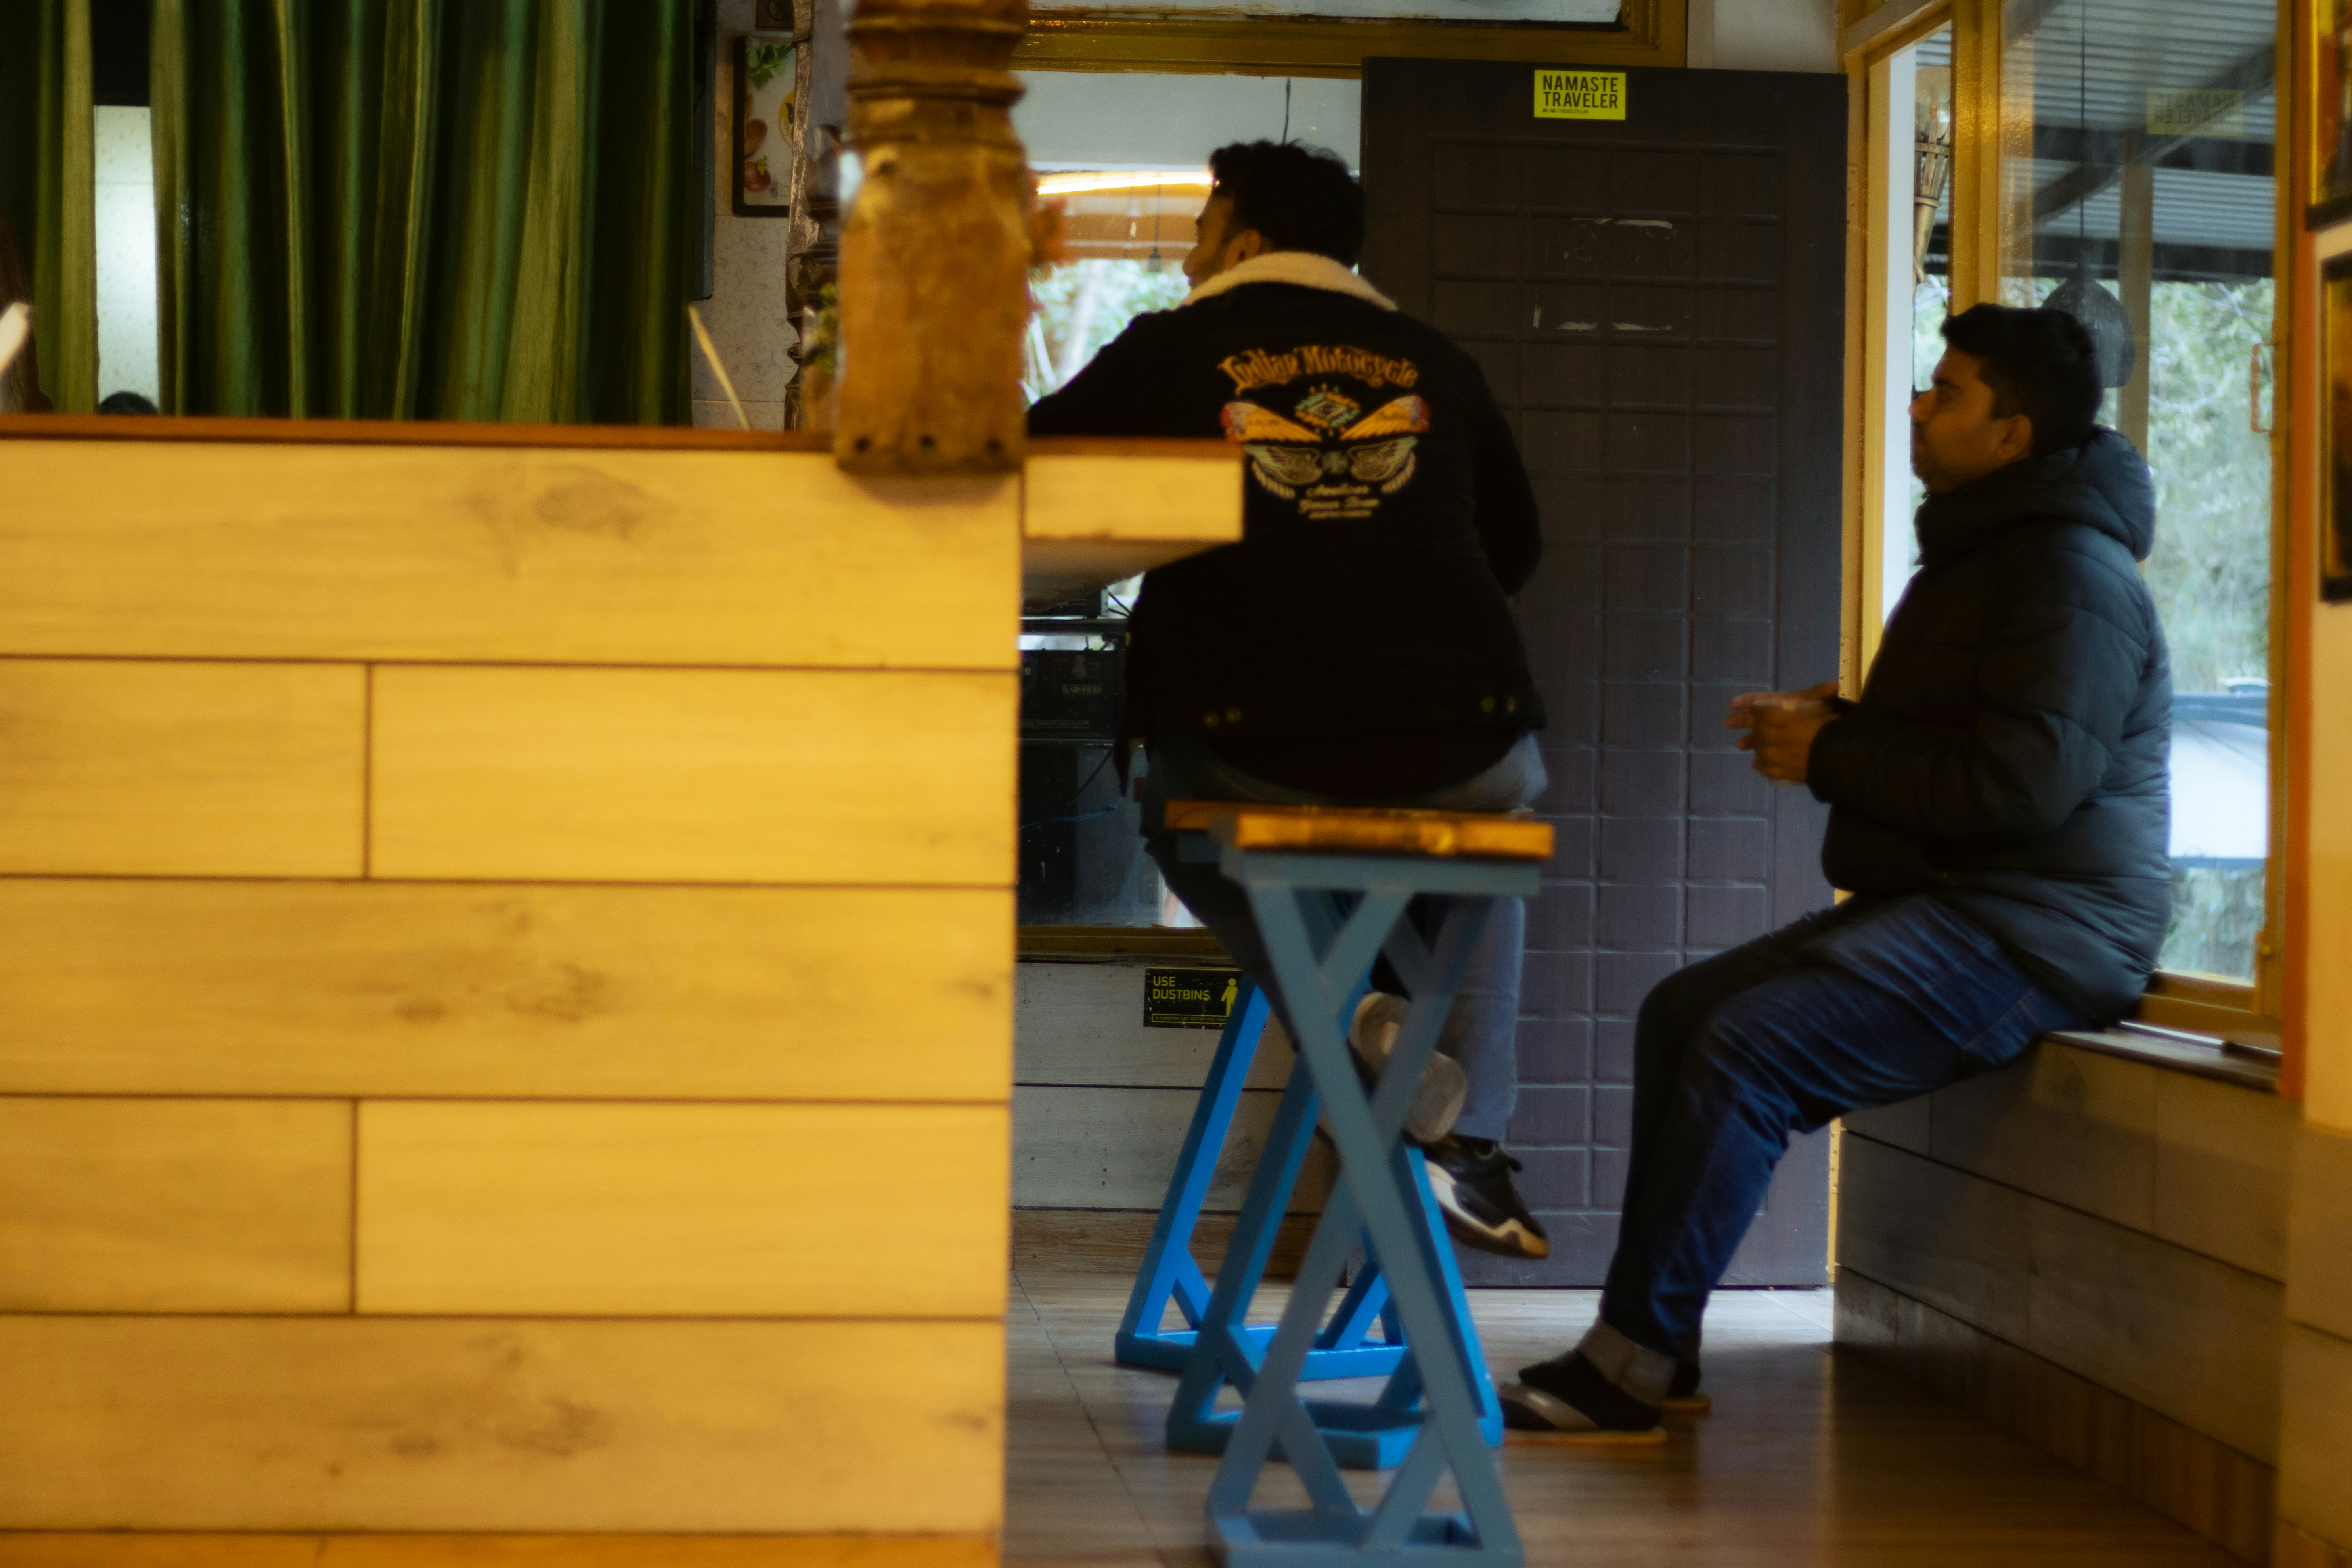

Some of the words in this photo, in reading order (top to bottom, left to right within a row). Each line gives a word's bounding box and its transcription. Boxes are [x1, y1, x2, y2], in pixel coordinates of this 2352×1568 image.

[1542, 75, 1618, 92] NAMASTE
[1543, 92, 1618, 109] TRAVELER
[1153, 976, 1176, 987] USE
[1152, 989, 1210, 1001] DUSTBINS
